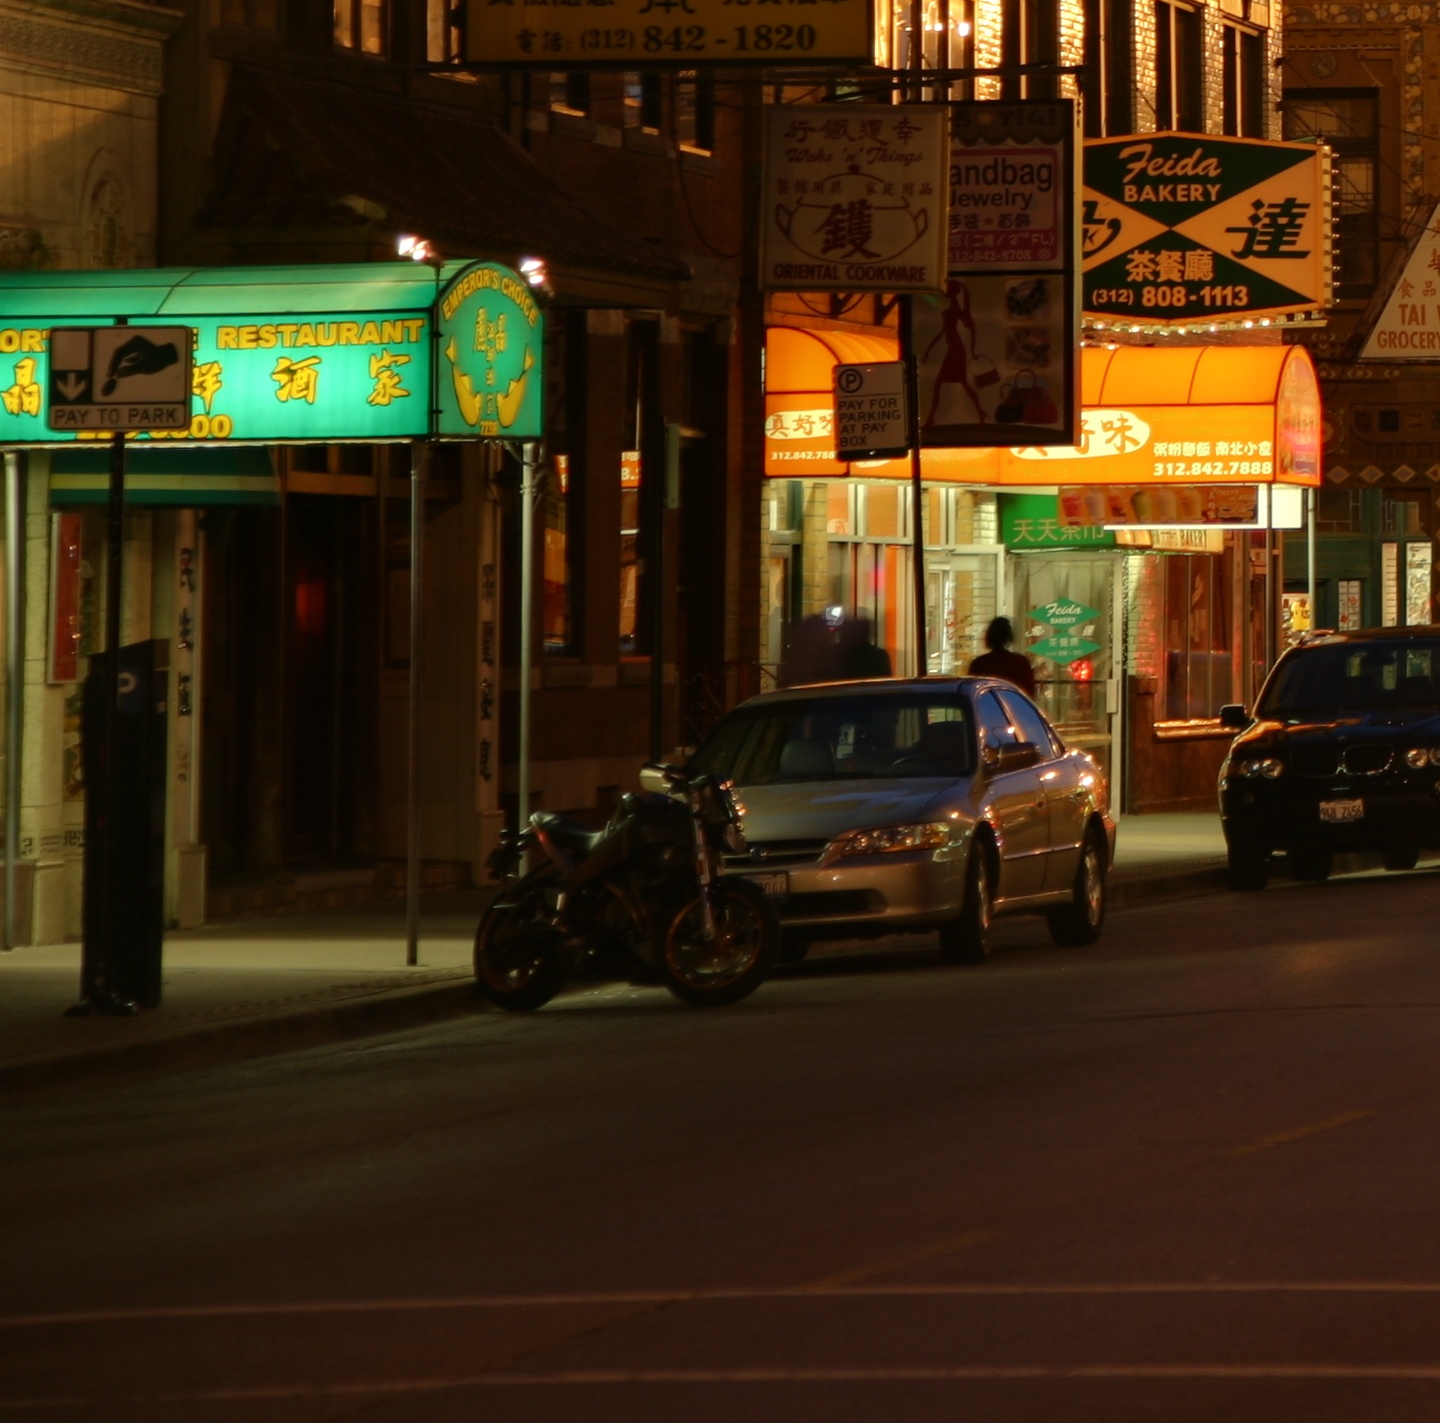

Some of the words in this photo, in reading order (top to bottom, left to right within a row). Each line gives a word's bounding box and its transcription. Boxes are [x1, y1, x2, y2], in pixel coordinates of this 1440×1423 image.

[865, 147, 923, 167] Things
[1118, 143, 1222, 183] Feida
[951, 157, 1053, 192] andbag
[1124, 184, 1221, 202] BAKERY
[774, 264, 839, 280] ORIENTAL
[845, 264, 926, 282] COOKWARE
[442, 268, 499, 320] EMPEROR'S
[501, 278, 537, 328] CHOICE
[1092, 289, 1133, 304] (312)
[1141, 286, 1247, 307] 808-1113
[1399, 305, 1425, 326] TAI
[217, 319, 424, 349] RESTAURANT
[839, 400, 861, 410] PAY
[869, 398, 897, 409] FOR
[54, 409, 87, 424] PAY
[98, 408, 119, 423] TO
[128, 407, 177, 423] PARK
[838, 410, 901, 423] PARKING
[841, 424, 856, 435] AT
[861, 423, 887, 434] PAY
[839, 436, 868, 447] BOX
[1153, 461, 1273, 476] 312.842.7888
